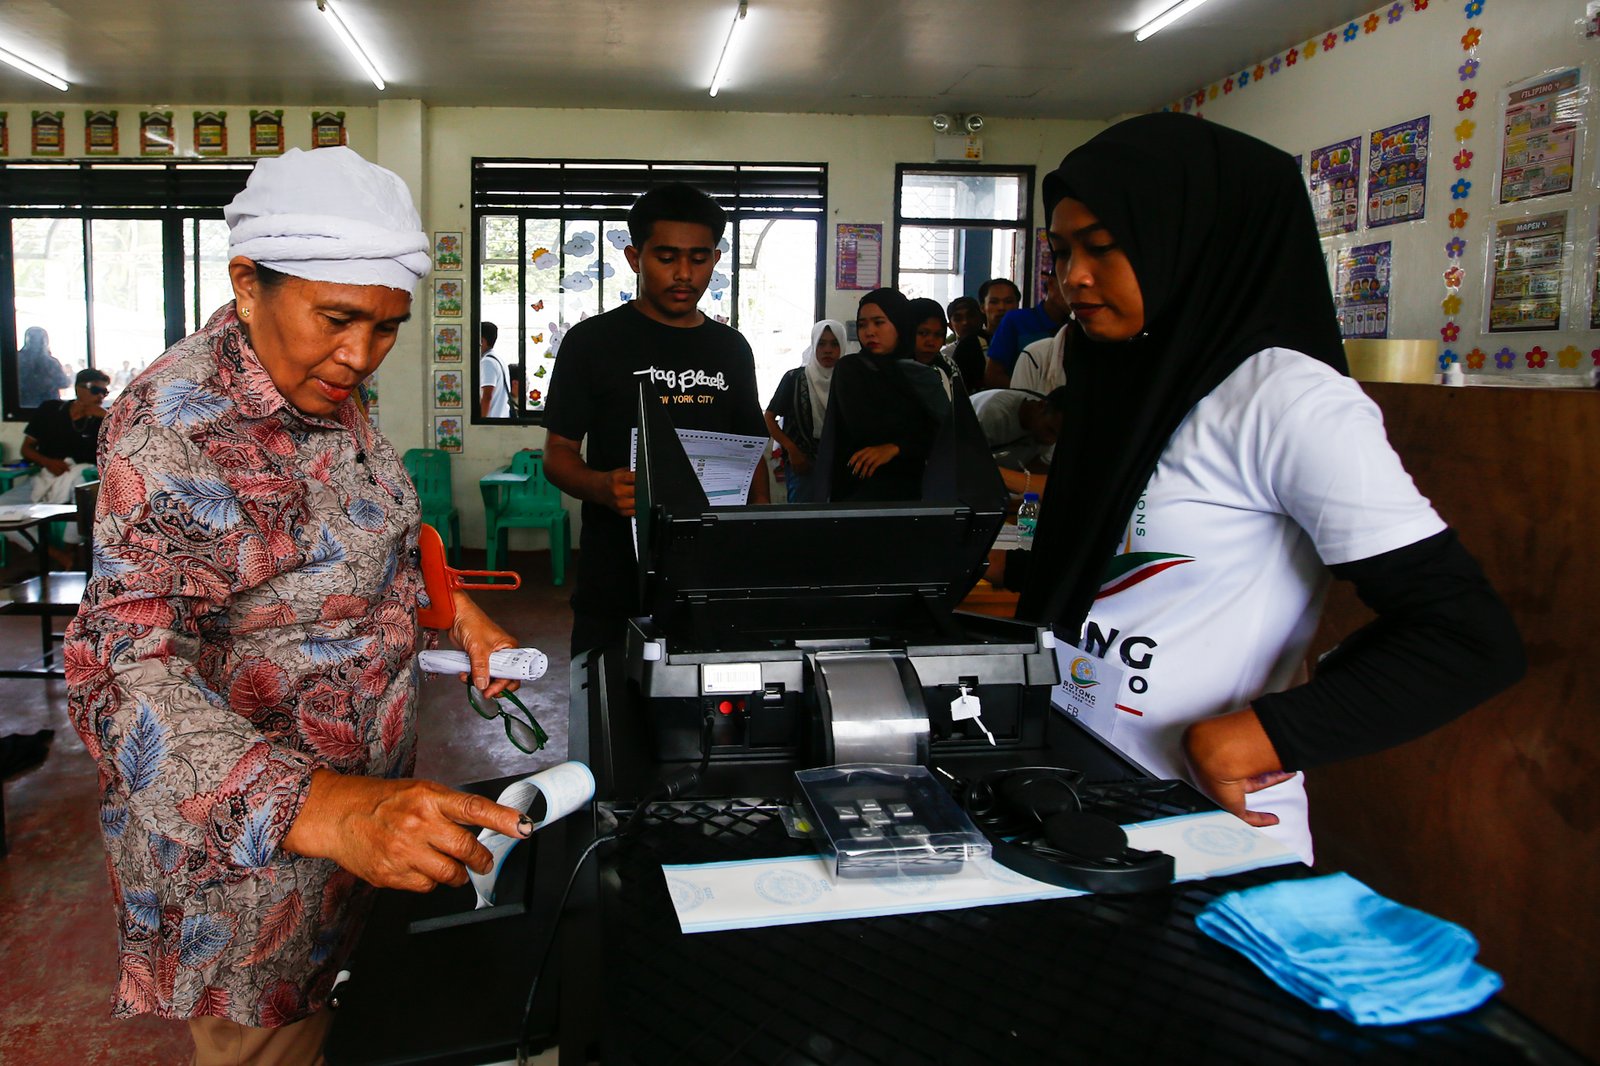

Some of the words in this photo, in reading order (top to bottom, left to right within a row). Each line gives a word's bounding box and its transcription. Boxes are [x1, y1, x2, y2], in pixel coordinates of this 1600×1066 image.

[1520, 84, 1553, 99] FILIPINO
[1381, 130, 1417, 153] PEACE
[1320, 147, 1351, 170] GAD
[678, 369, 729, 393] Black
[672, 395, 694, 404] YORK
[697, 395, 714, 404] CITY
[1063, 680, 1096, 702] BOTONG
